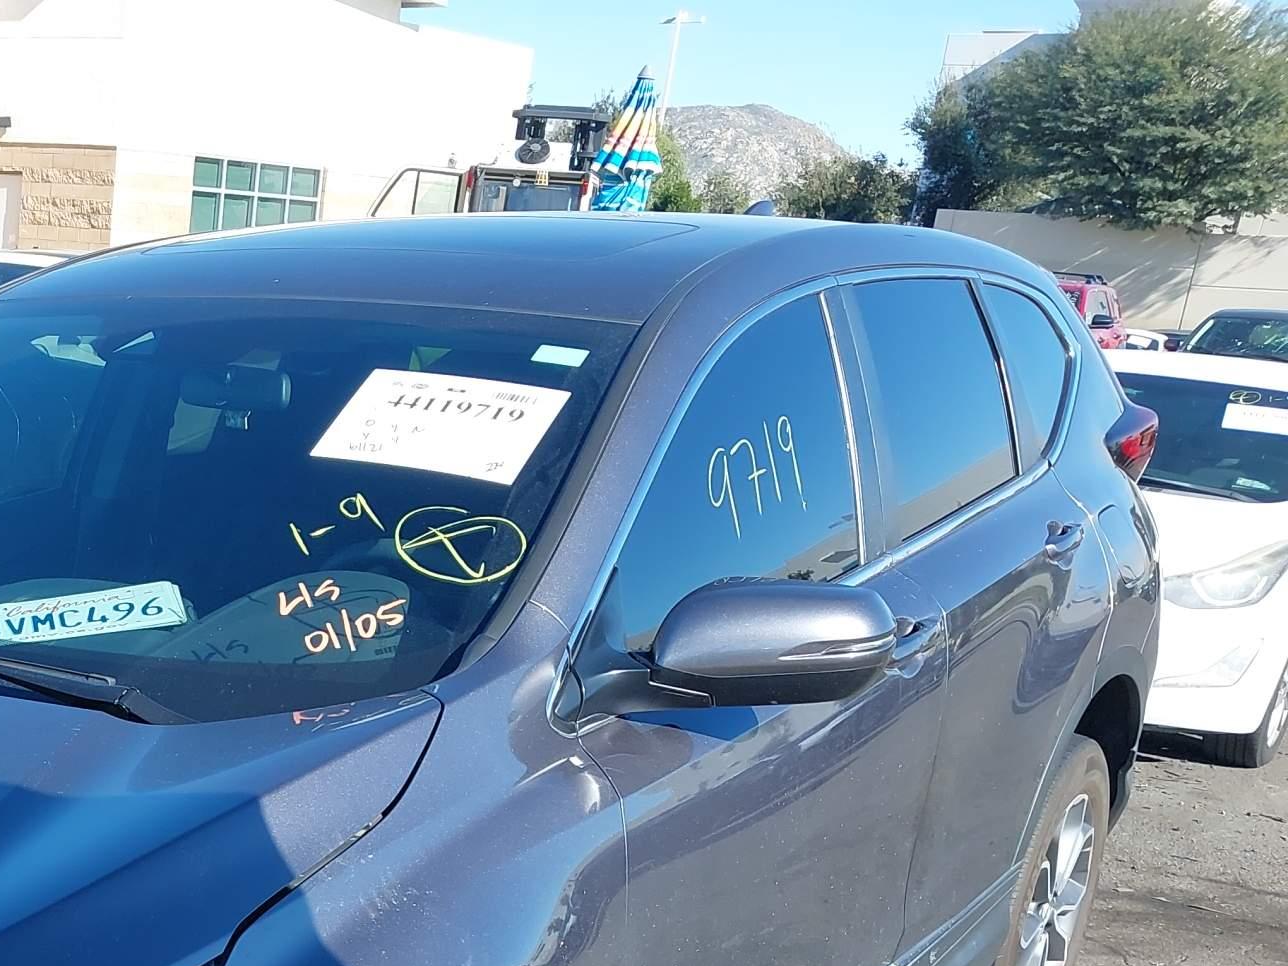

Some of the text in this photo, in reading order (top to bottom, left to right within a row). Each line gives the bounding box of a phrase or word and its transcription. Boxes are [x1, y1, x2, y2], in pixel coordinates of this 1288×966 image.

[387, 393, 525, 422] 44119719
[708, 415, 808, 541] 9719
[289, 492, 386, 556] 1-9
[5, 593, 124, 618] California
[303, 599, 407, 652] 01/05
